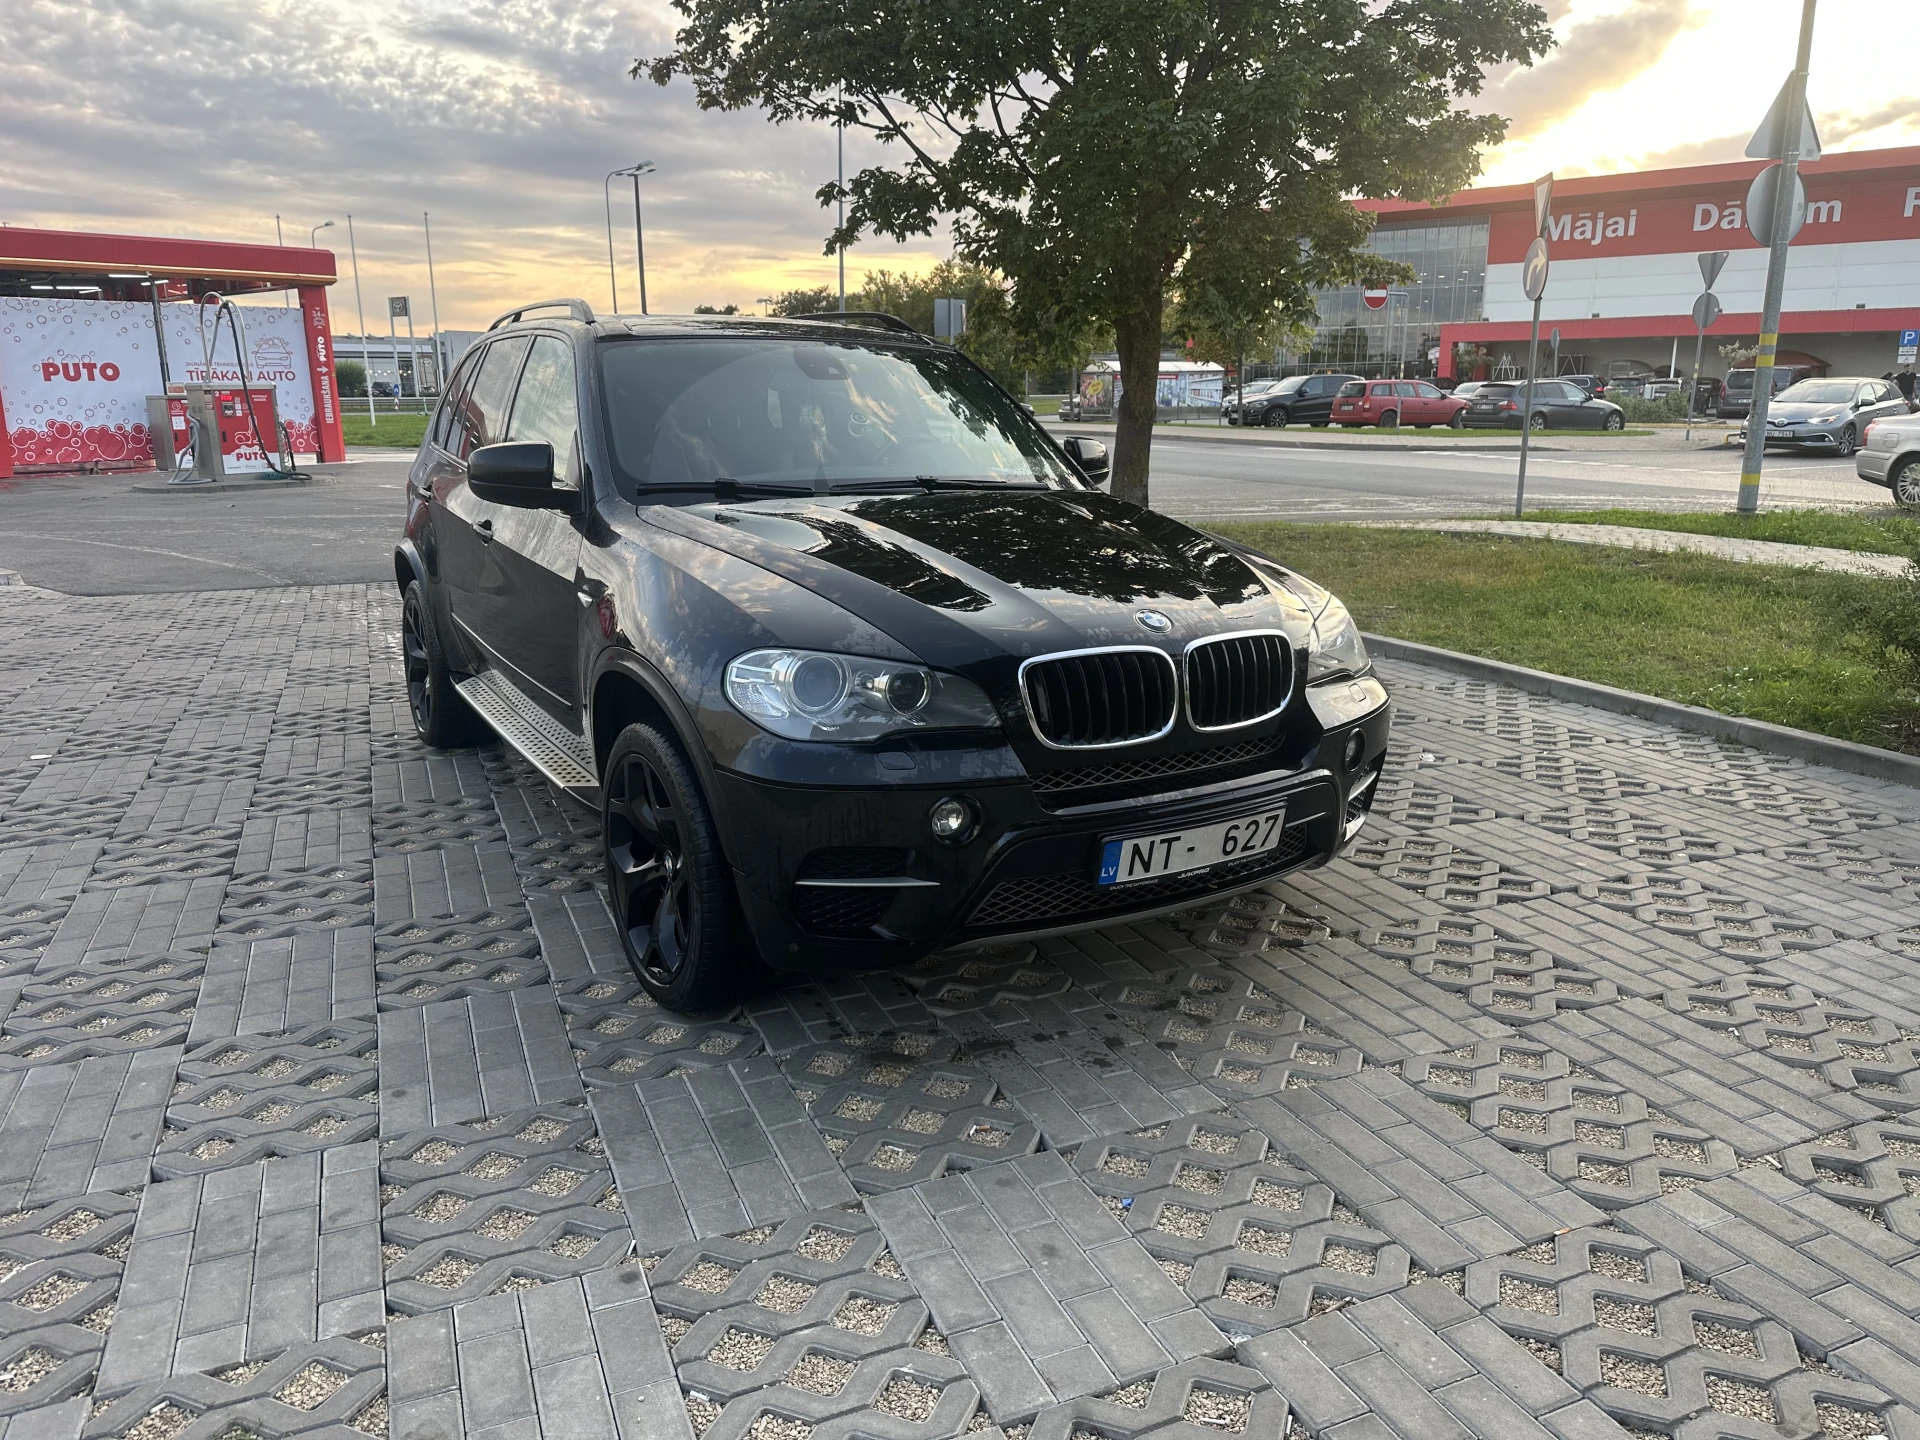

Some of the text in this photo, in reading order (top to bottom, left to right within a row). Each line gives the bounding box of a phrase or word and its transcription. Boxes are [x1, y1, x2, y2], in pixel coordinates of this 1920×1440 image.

[1548, 209, 1637, 246] Mājai
[1692, 200, 1842, 232] Dām
[1904, 331, 1915, 344] P
[317, 336, 327, 362] PUTO
[41, 362, 120, 381] PUTO
[257, 371, 295, 381] AUTO
[320, 375, 335, 424] IEBRAUKŠANA
[1222, 814, 1280, 856] 627
[1101, 867, 1116, 877] LV
